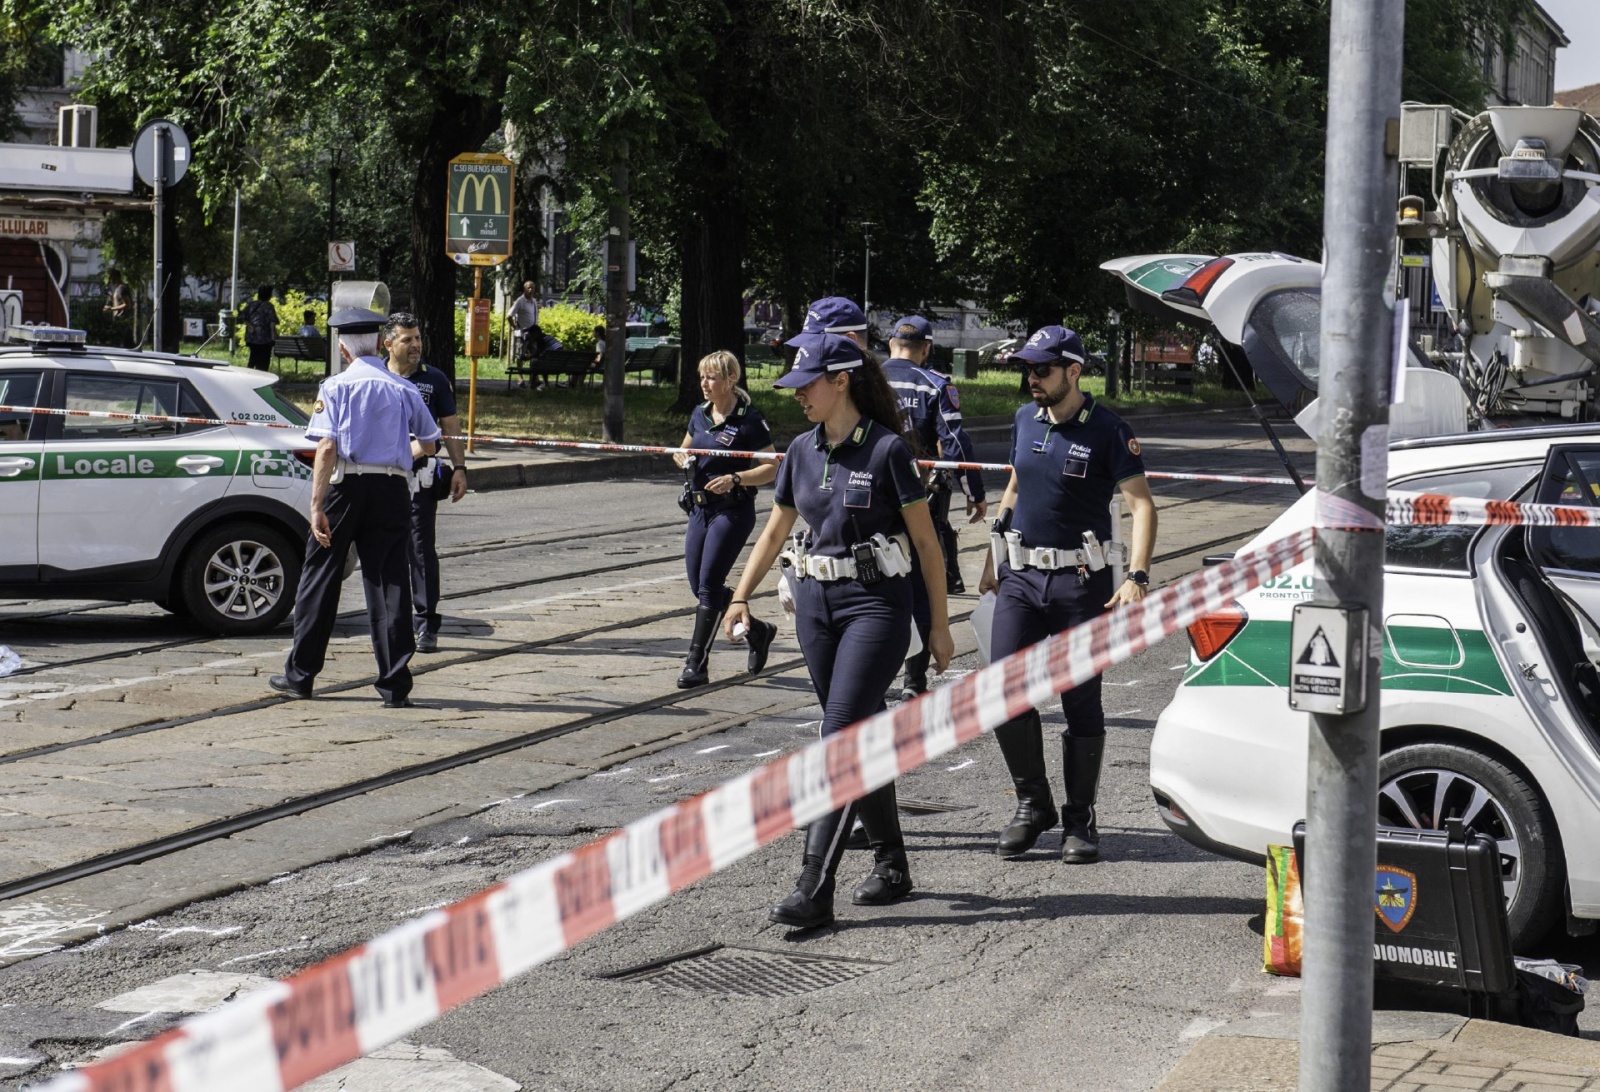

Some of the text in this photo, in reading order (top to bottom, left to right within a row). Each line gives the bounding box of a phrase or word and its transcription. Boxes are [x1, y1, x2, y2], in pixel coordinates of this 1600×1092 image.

[453, 164, 508, 174] C.SO BUENOS AIRES
[0, 219, 48, 235] LLULARI
[488, 218, 494, 228] 5
[480, 228, 498, 236] minuti
[253, 413, 277, 421] 0208
[1071, 443, 1092, 454] Polizia
[1068, 449, 1090, 459] Locale
[57, 454, 155, 475] Locale
[850, 471, 873, 480] Polizia
[848, 478, 872, 487] Locale
[1261, 573, 1315, 589] 02.0
[1299, 676, 1337, 687] RISERVATO
[1294, 684, 1341, 694] NON VEDENTI
[1373, 944, 1458, 969] DIOMOBILE
